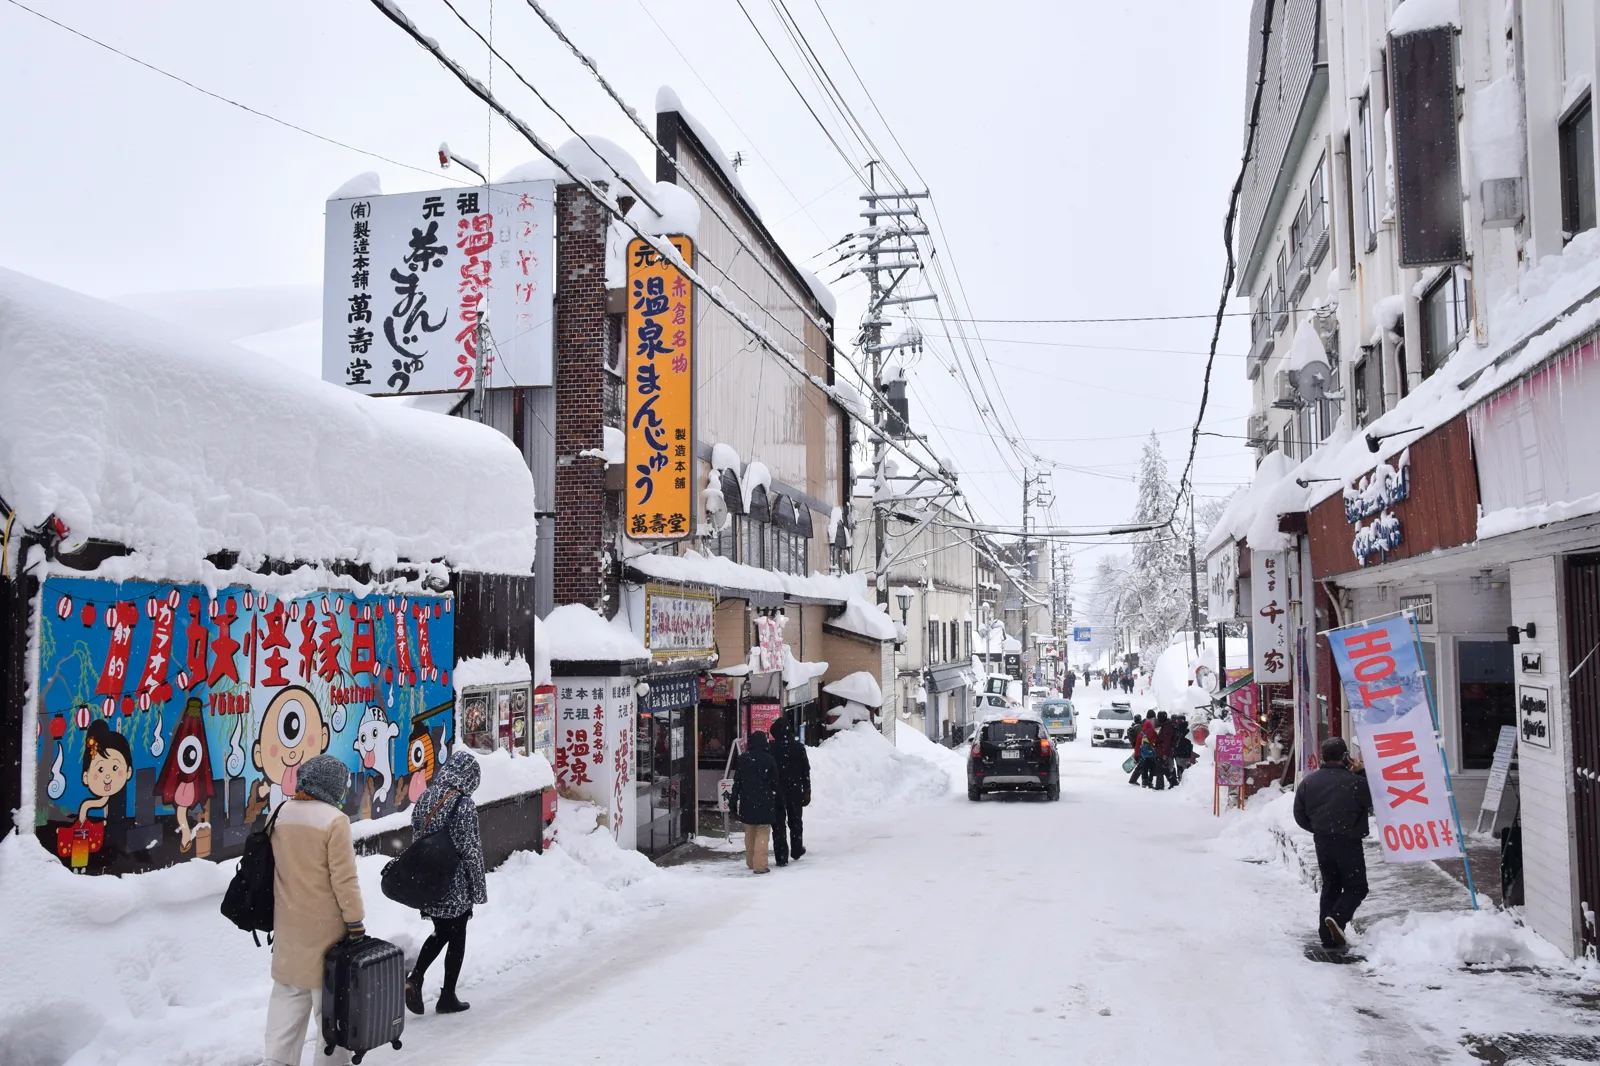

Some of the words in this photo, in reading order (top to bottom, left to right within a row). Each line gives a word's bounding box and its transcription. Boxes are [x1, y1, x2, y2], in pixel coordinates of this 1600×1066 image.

[421, 192, 481, 220] 元祖
[634, 245, 685, 267] 元
[383, 221, 449, 393] 茶まんじゅう
[671, 275, 688, 375] 赤倉名物
[632, 276, 675, 506] 温泉まんじゅう
[674, 428, 687, 490] 製造本舗
[107, 621, 131, 680] 射的
[144, 603, 172, 694] カラオケ
[186, 608, 375, 689] 妖怪縁日
[208, 691, 250, 717] Yōkai
[330, 683, 375, 705] Festival
[562, 708, 590, 720] 元祖
[566, 729, 594, 787] 温泉
[592, 704, 604, 765] 赤倉名物
[1217, 738, 1243, 746] もちもち
